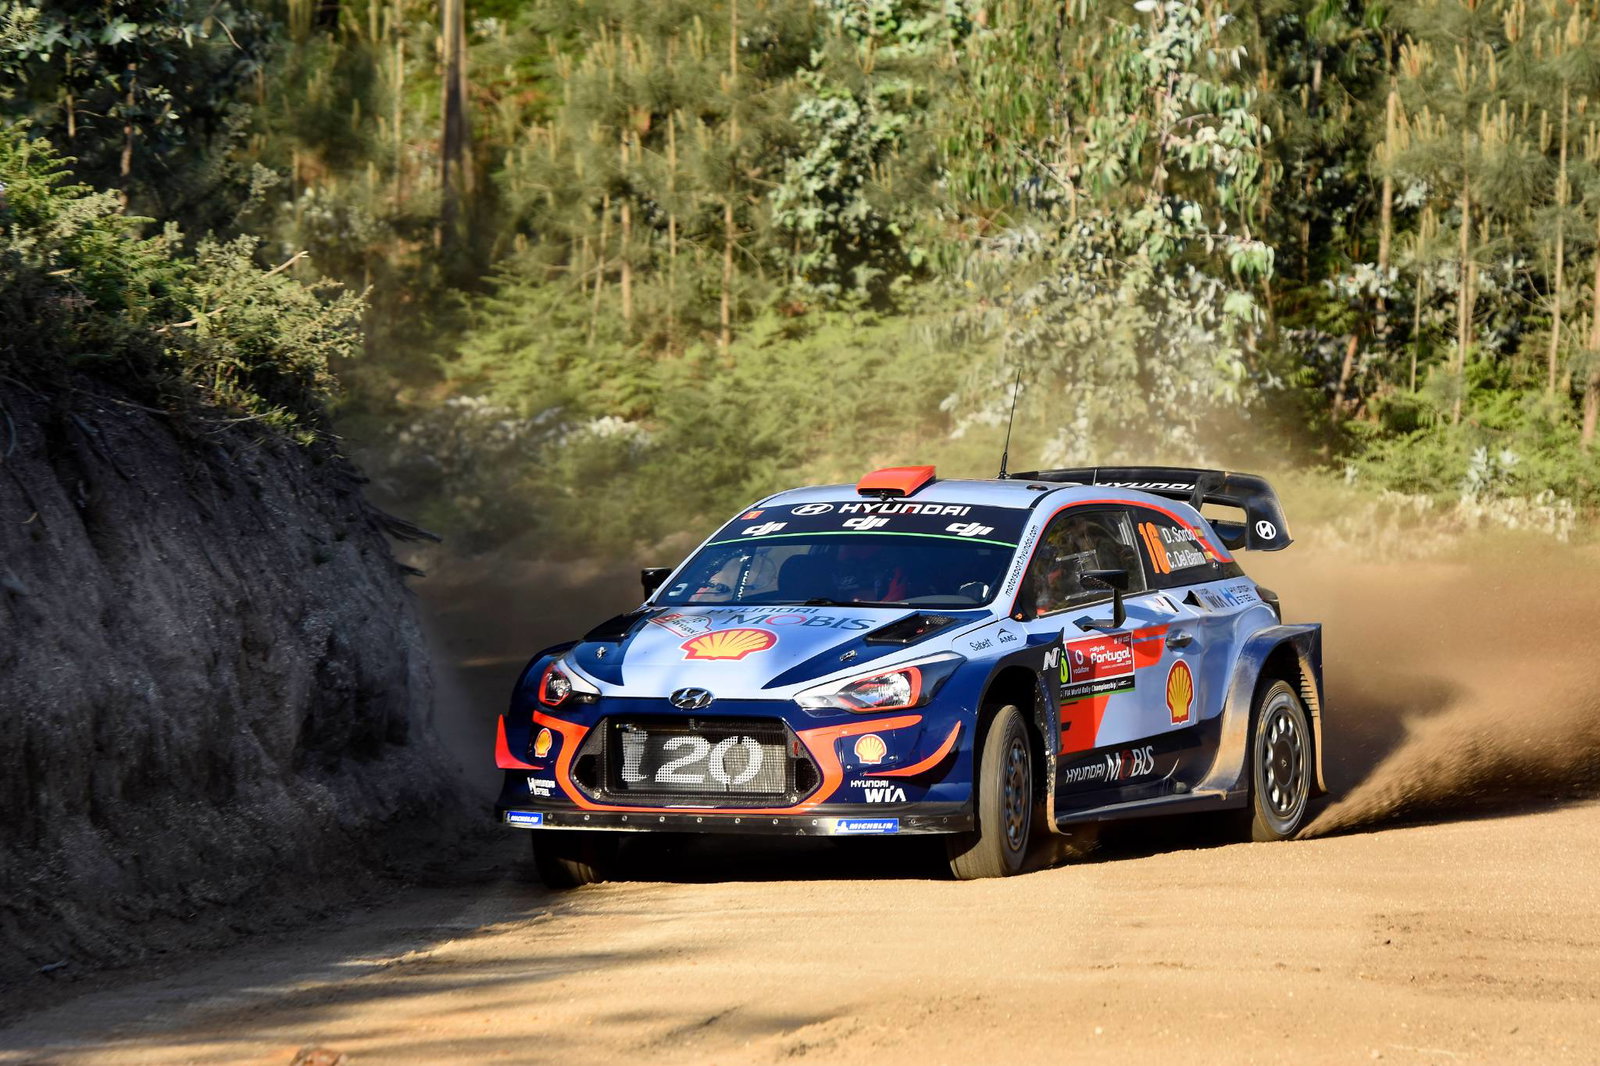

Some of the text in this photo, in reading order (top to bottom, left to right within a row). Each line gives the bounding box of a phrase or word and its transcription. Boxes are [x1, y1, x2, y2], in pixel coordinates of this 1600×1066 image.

[838, 503, 971, 516] HYUNDAI
[1138, 521, 1171, 575] 16
[706, 607, 820, 615] HYUNDAI
[721, 614, 877, 631] MOBIS
[1090, 646, 1131, 664] Portugal
[1065, 745, 1155, 784] HYUNDAI MOBIS
[850, 780, 889, 788] HYUNDAI
[849, 822, 893, 830] MICHELIN
